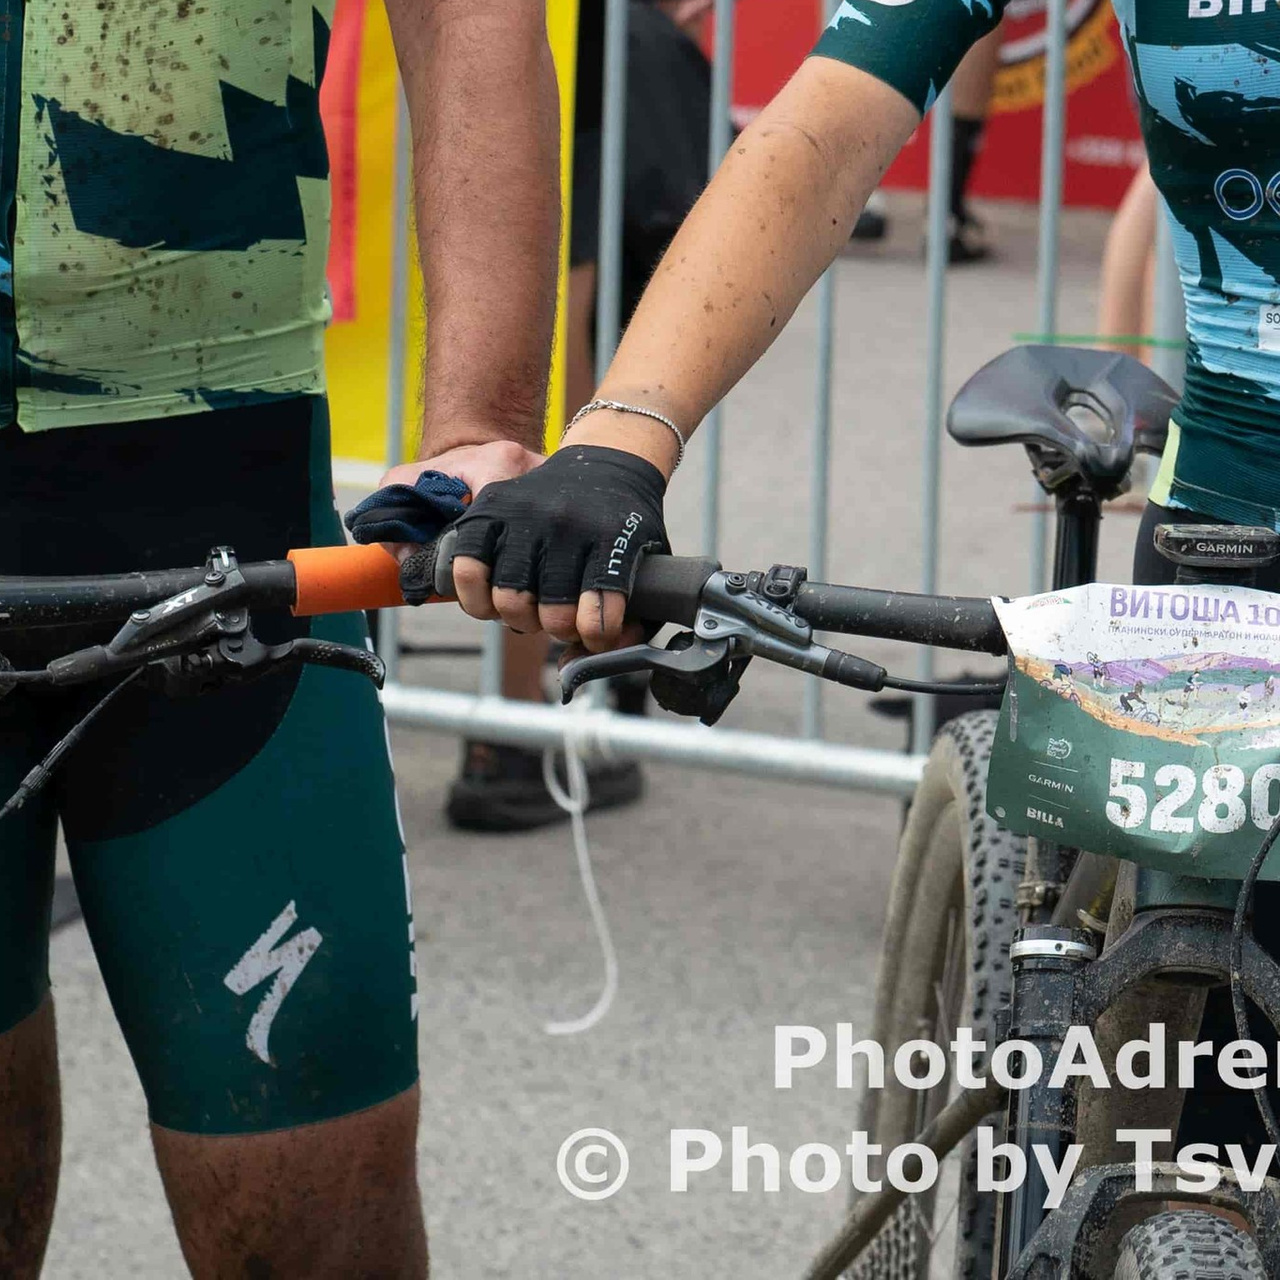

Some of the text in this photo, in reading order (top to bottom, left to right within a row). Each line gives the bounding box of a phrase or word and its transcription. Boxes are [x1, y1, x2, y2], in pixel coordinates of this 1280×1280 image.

[607, 511, 643, 576] CASTELLI
[1196, 542, 1254, 554] GARMIN
[1110, 586, 1242, 624] ВИТОША
[1028, 773, 1074, 794] GARMIN
[1026, 806, 1065, 829] BILLA
